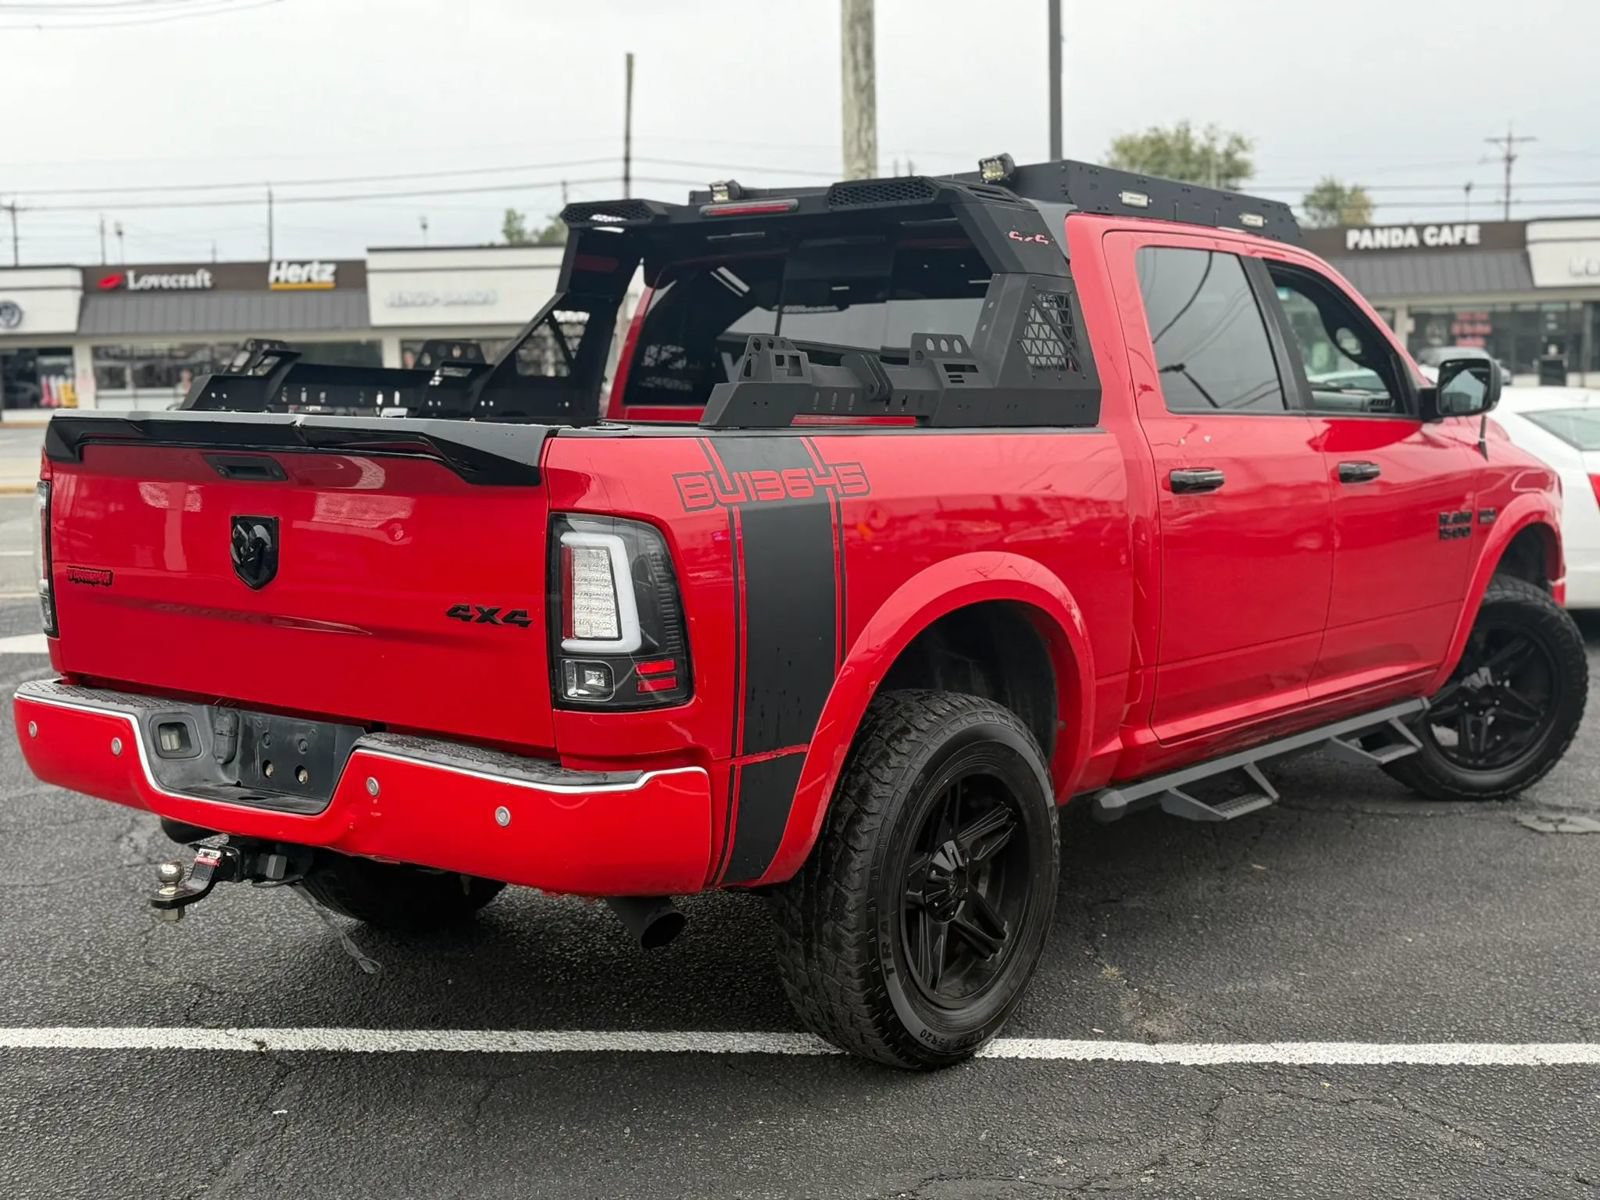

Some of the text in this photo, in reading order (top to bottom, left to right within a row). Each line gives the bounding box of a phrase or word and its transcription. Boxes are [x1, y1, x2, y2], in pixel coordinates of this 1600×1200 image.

[1346, 225, 1480, 249] PANDA CAFE
[126, 268, 212, 291] Lovecraft
[268, 261, 337, 283] Hertz
